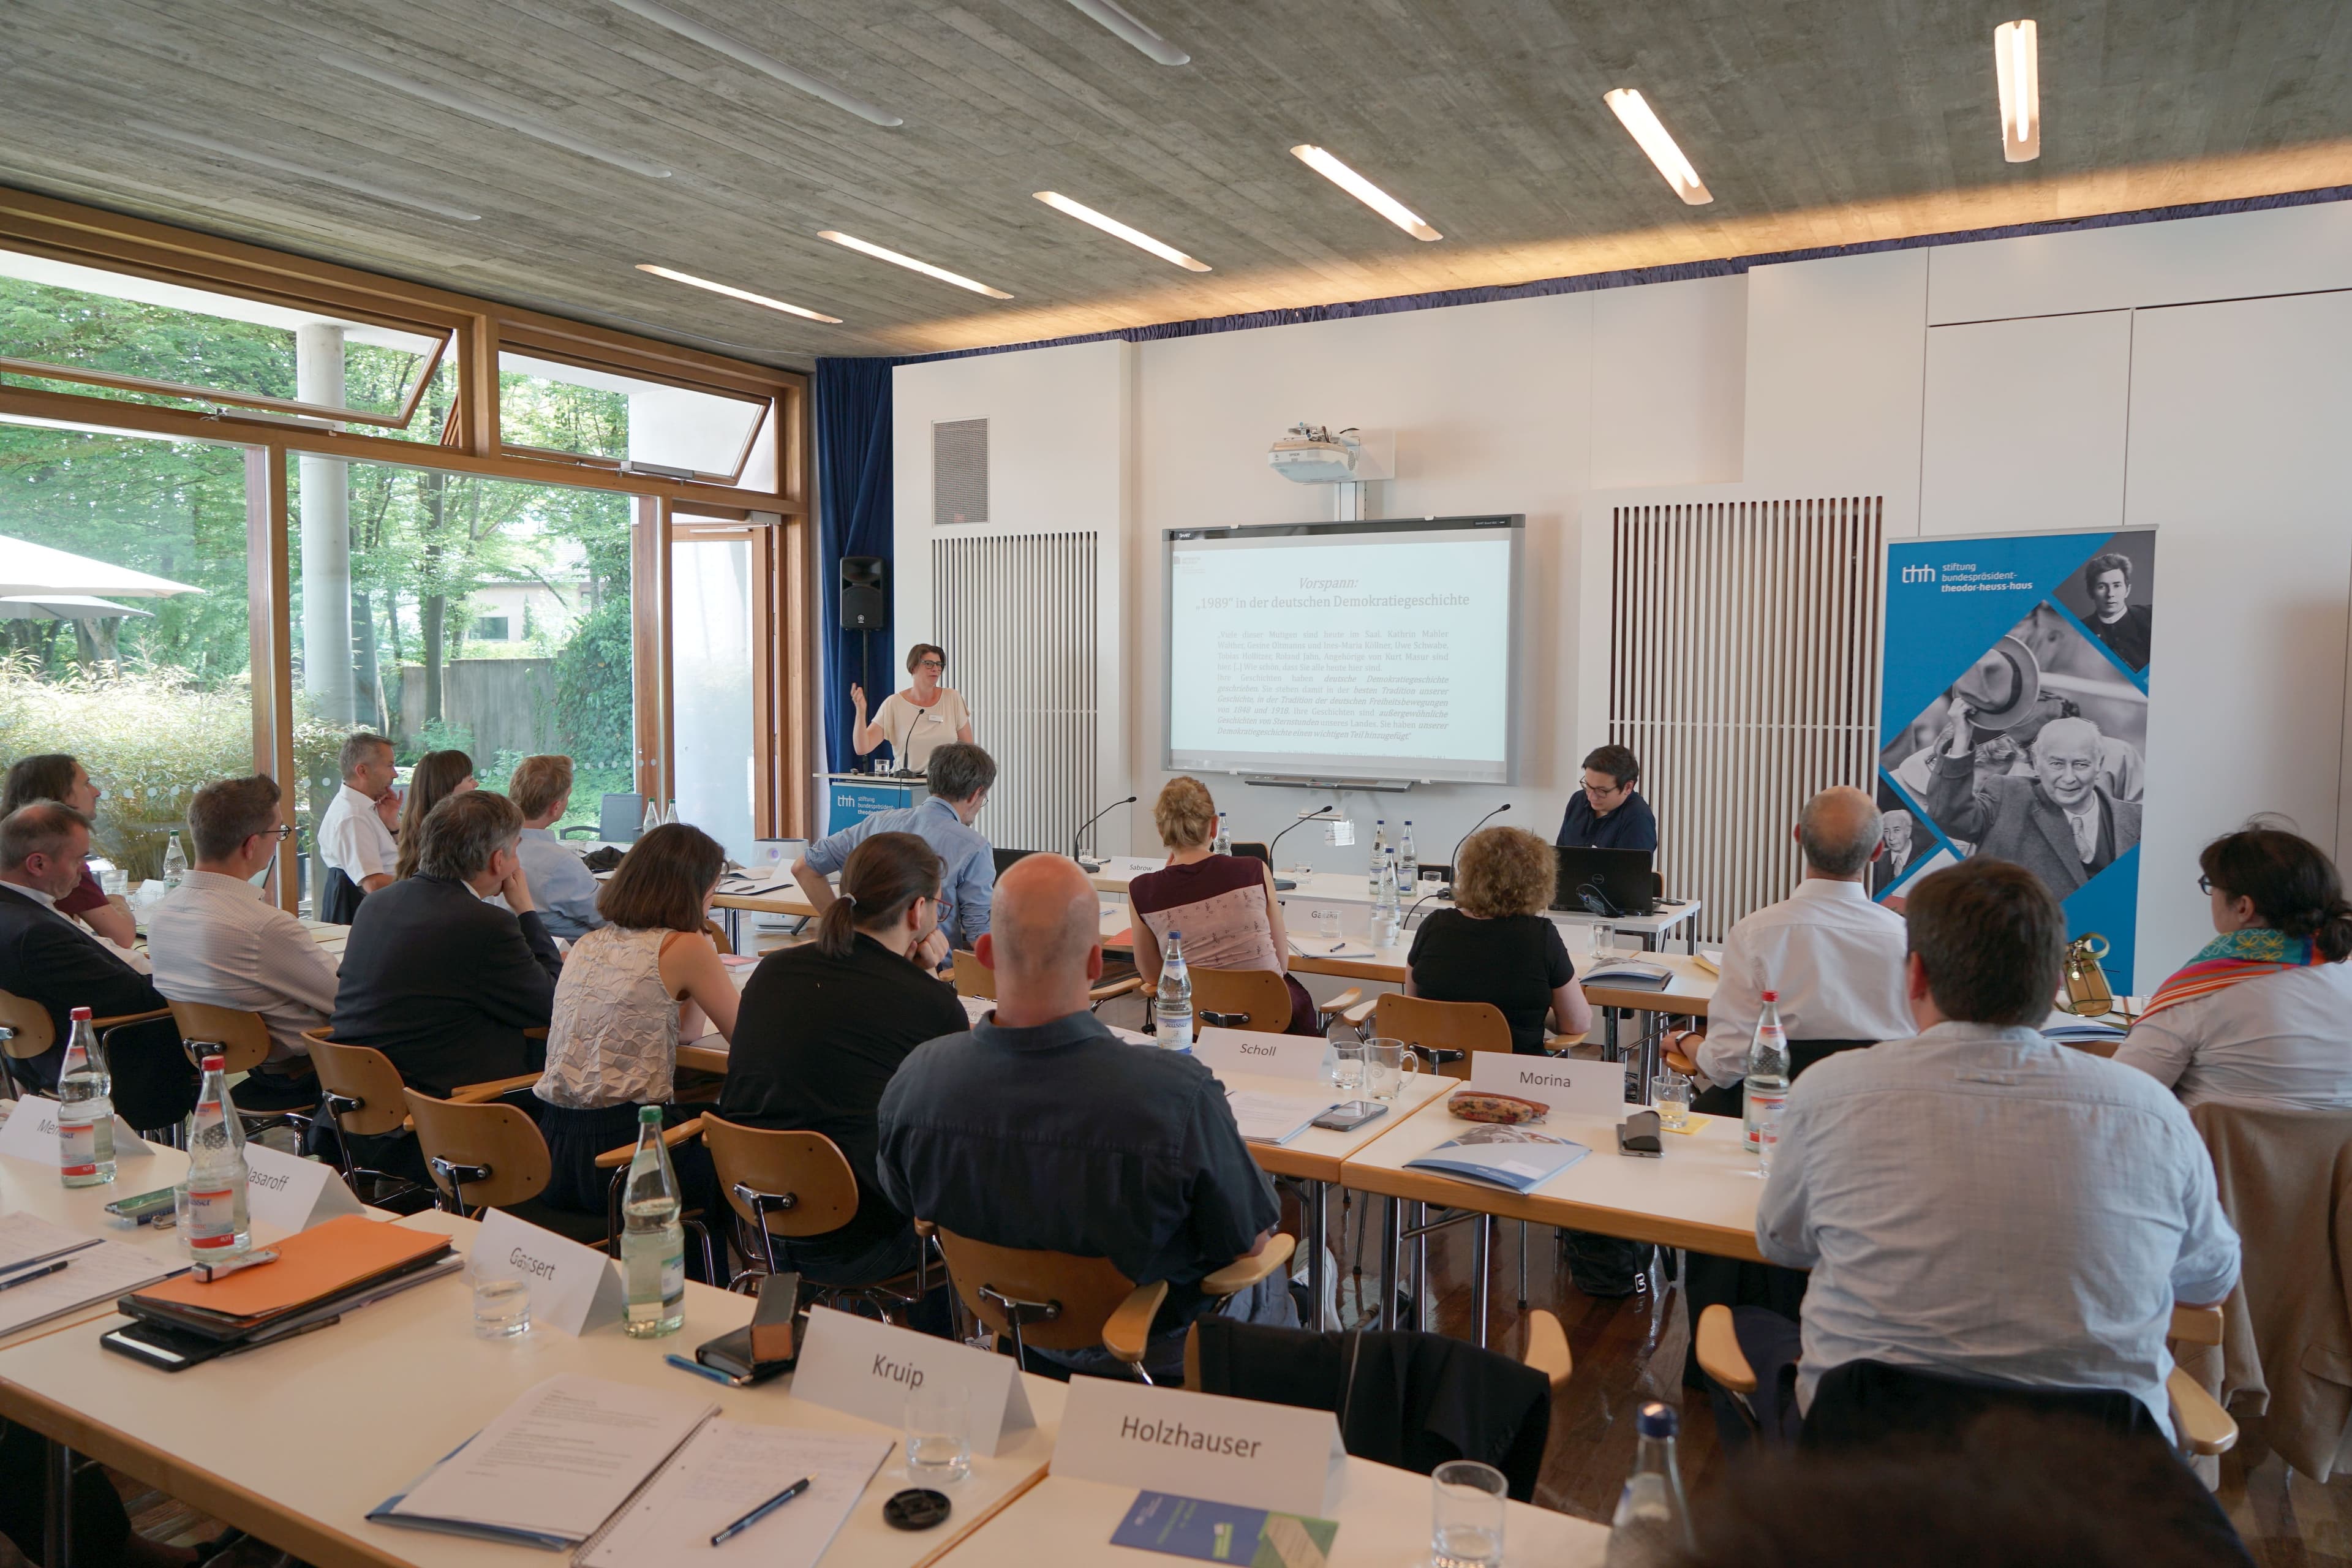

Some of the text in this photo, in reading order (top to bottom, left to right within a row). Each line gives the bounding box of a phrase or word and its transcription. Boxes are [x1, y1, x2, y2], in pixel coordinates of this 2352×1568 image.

[1942, 563, 1976, 571] stiftung
[1942, 572, 2018, 582] bundespräsident-
[1299, 577, 1359, 592] Vorspann:
[1941, 582, 2033, 592] theodor-heuss-haus
[1236, 598, 1246, 608] in
[1250, 597, 1268, 608] der
[1271, 596, 1330, 607] deutschen
[1334, 593, 1470, 608] Demokratiegeschichte
[1367, 675, 1449, 685] Demokratiegeschichte
[1370, 698, 1449, 708] Freiheitsbewegungen
[1312, 707, 1354, 716] Geschichten
[1379, 709, 1449, 718] außergewöhnliche
[1218, 727, 1292, 737] Demokratiegeschichte
[1314, 729, 1348, 739] wichtigen
[1240, 1044, 1276, 1056] Scholl
[1520, 1071, 1570, 1087] Morina
[249, 1166, 289, 1191] asaroff
[872, 1353, 924, 1390] Kruip
[1121, 1415, 1262, 1458] Holzhauser
